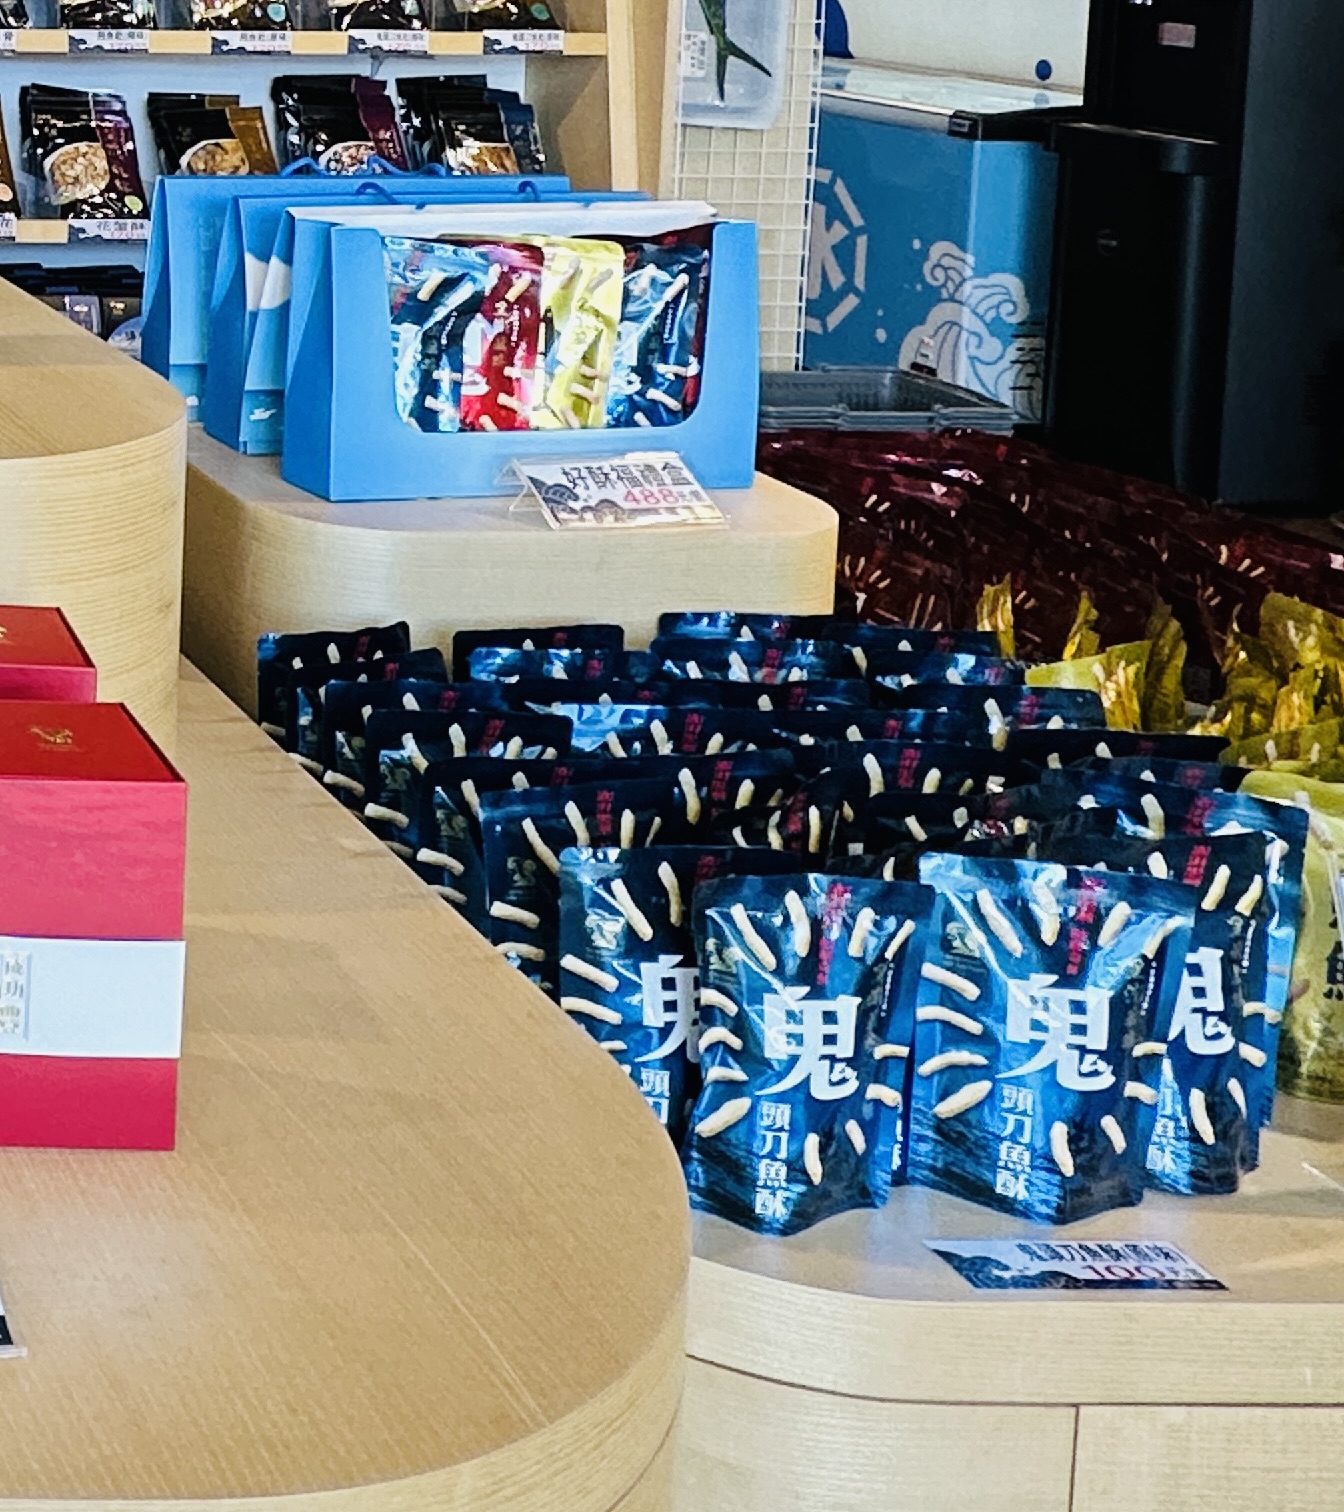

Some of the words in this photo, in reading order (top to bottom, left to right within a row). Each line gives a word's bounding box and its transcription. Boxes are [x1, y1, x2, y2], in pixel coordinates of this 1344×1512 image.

[755, 985, 863, 1102] 鬼
[994, 972, 1117, 1093] 鬼
[754, 1101, 793, 1223] 頭刀魚酥
[994, 1084, 1035, 1202] 頭刀魚酥
